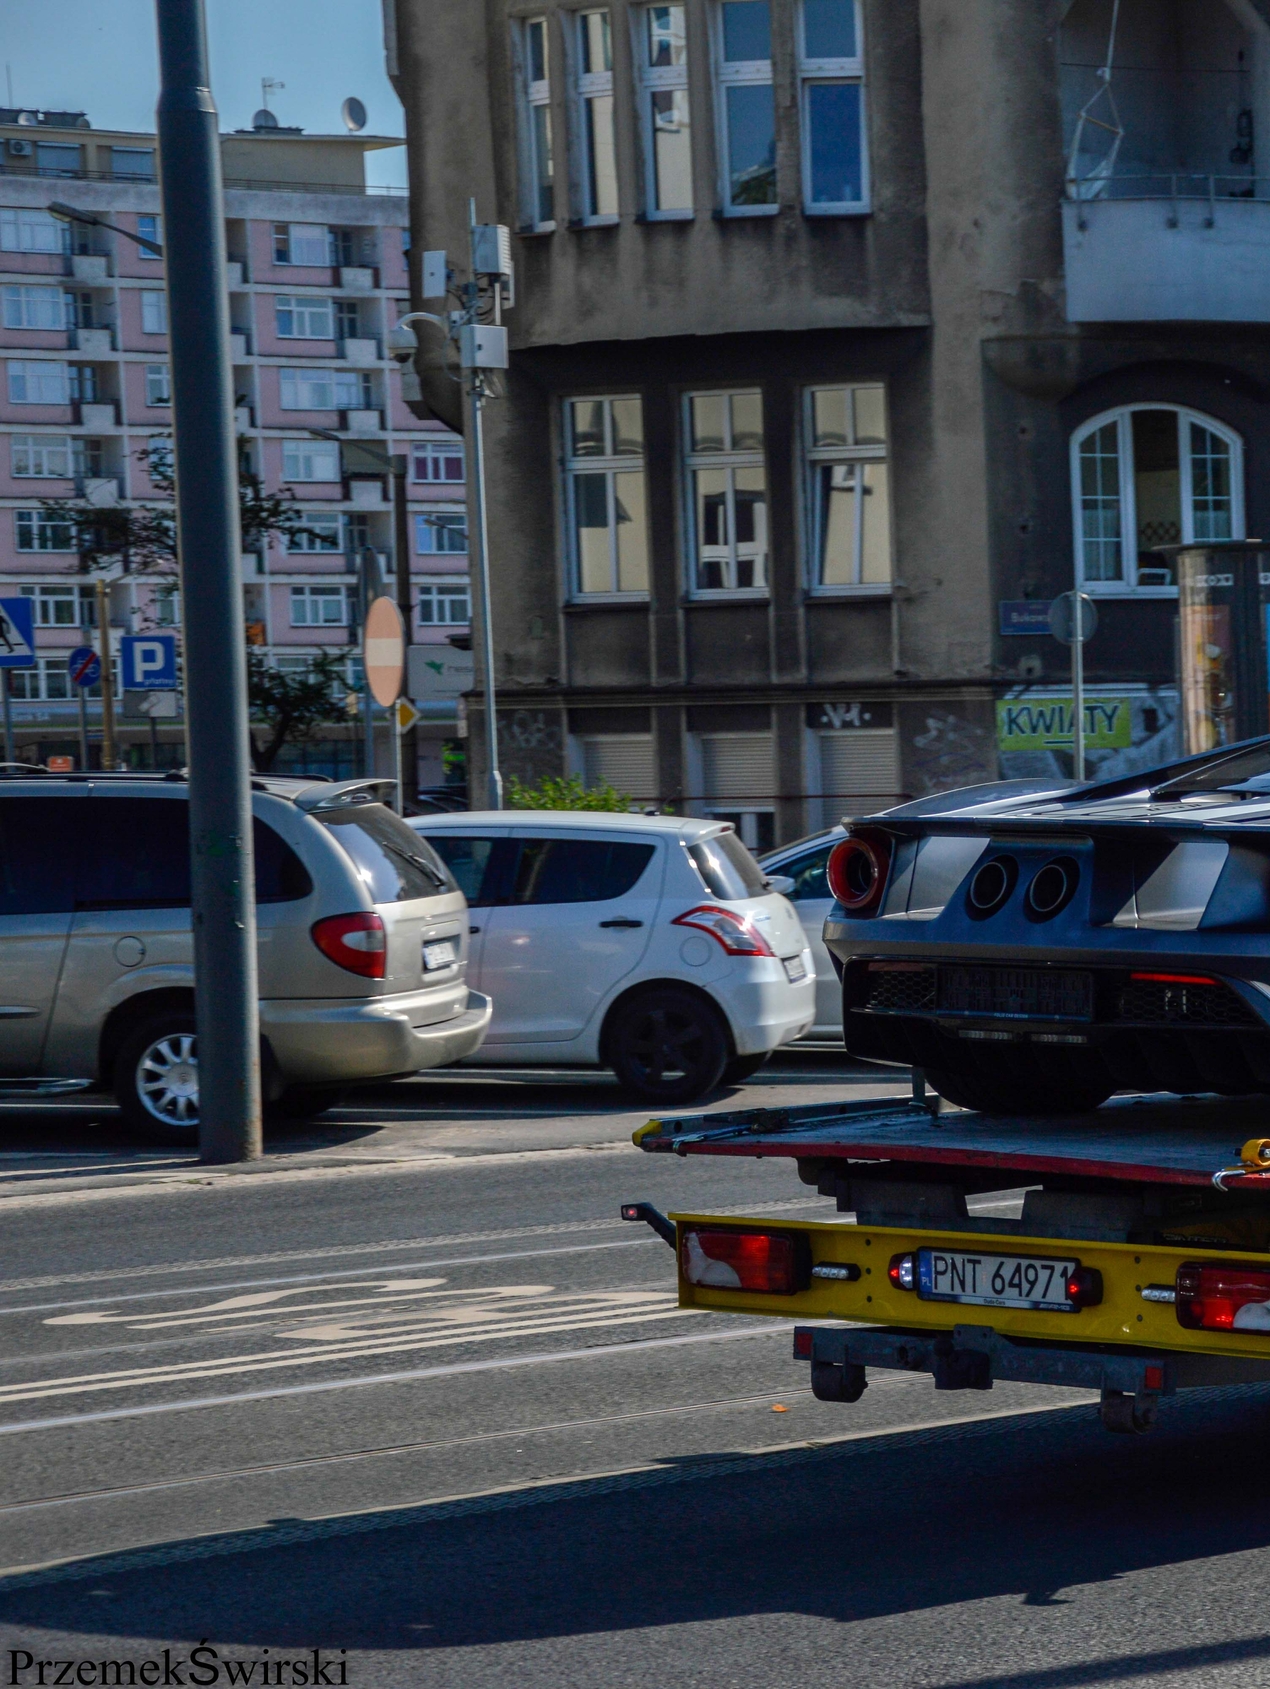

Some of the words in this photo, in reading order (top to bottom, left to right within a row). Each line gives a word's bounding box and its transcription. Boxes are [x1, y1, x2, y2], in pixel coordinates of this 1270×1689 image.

[133, 641, 165, 682] P
[922, 1277, 931, 1287] PL
[933, 1255, 982, 1294] PNT
[991, 1261, 1070, 1301] 64971
